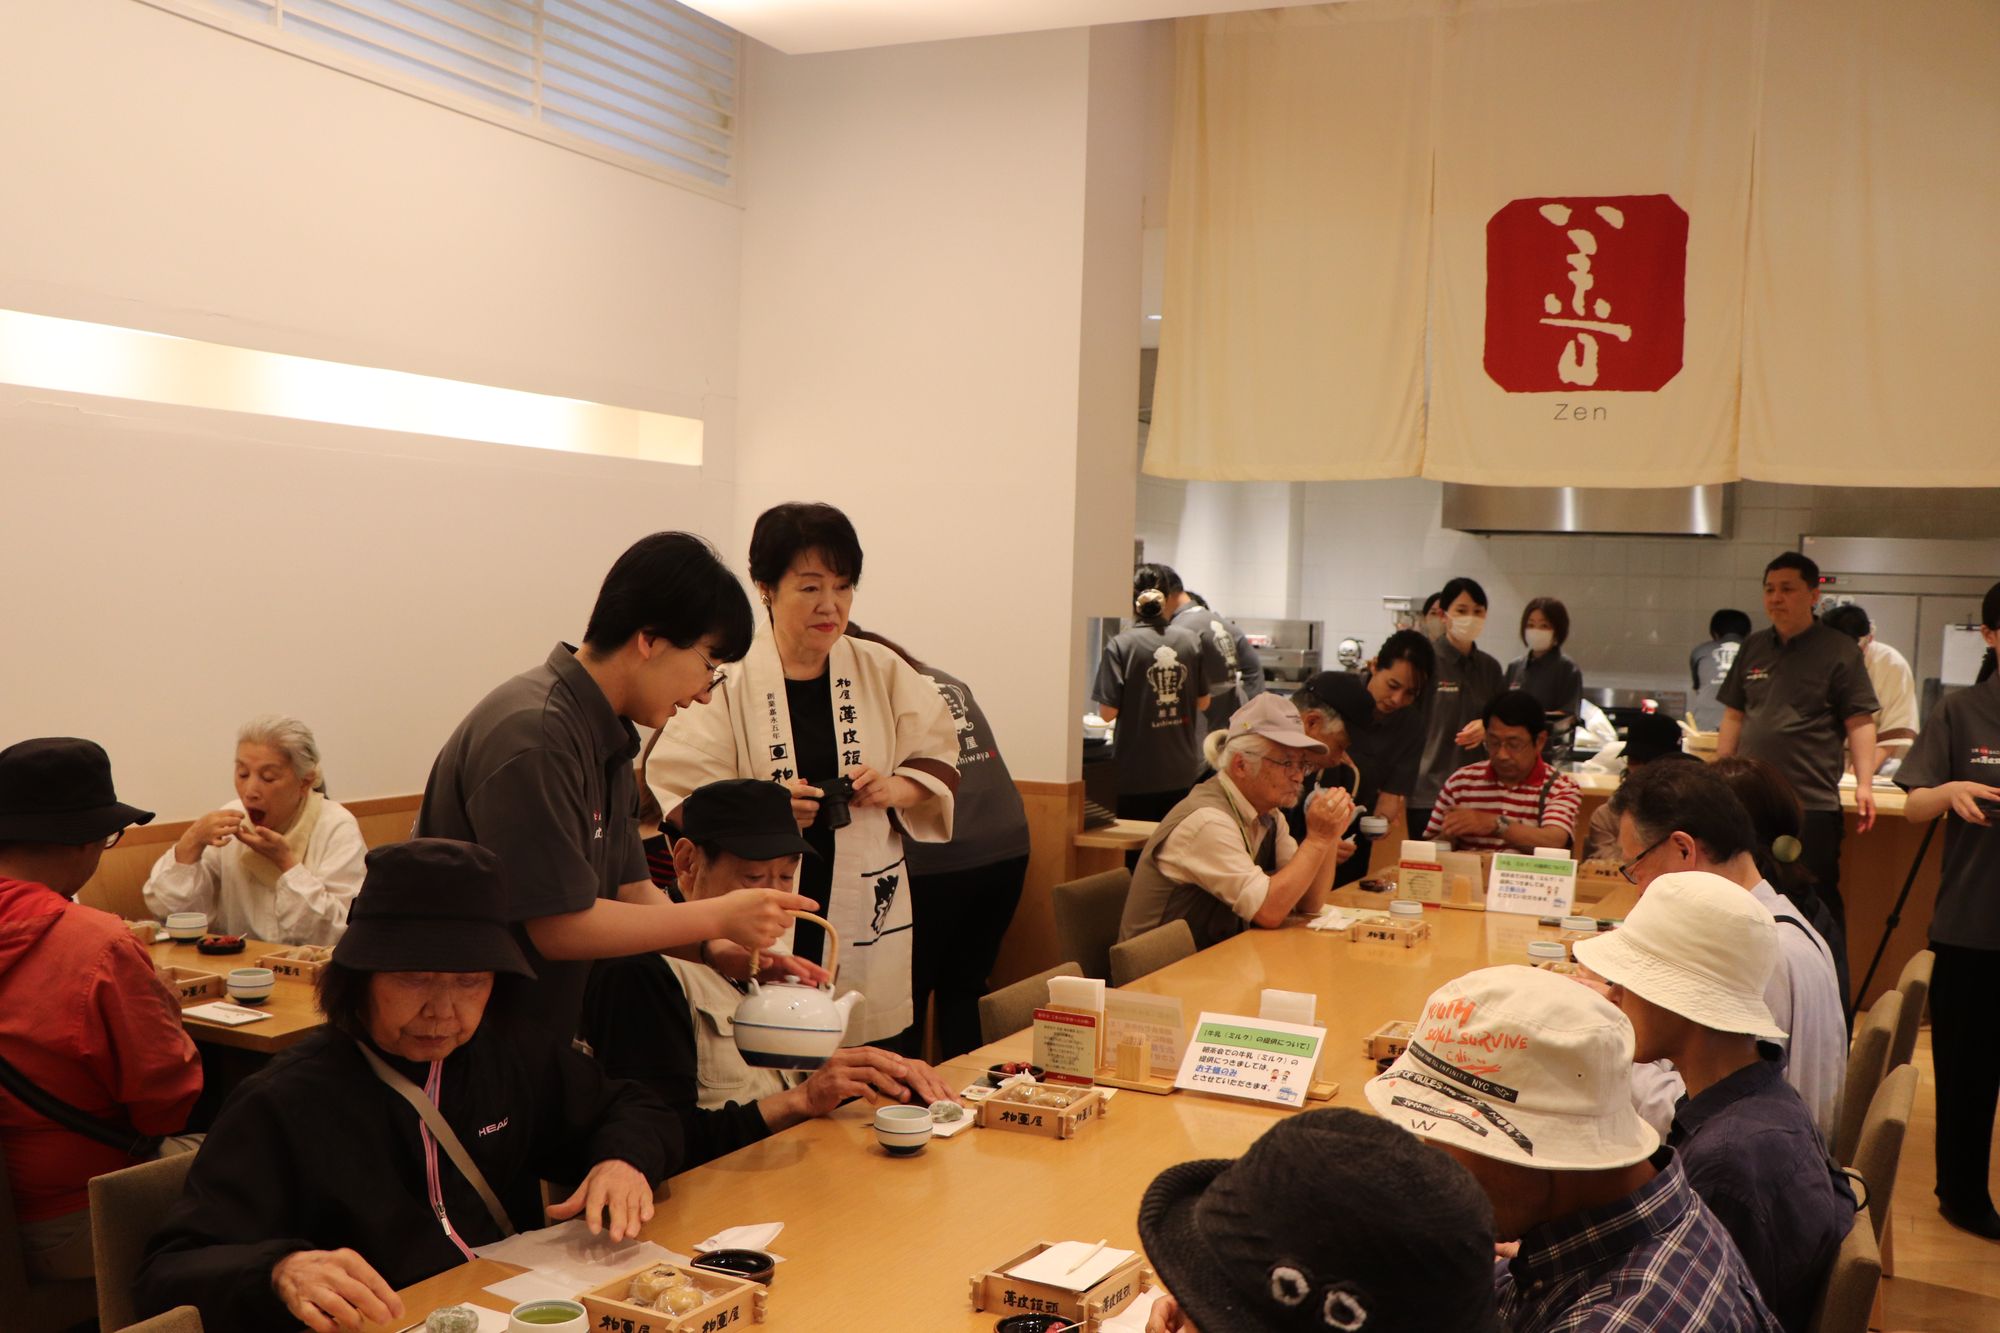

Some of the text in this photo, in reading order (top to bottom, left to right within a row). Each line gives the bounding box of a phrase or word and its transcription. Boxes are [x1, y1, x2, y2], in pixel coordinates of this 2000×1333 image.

[1554, 403, 1607, 421] Zen
[1413, 1073, 1443, 1090] RULES
[1471, 1079, 1490, 1092] NYC
[478, 1117, 508, 1137] HEAD
